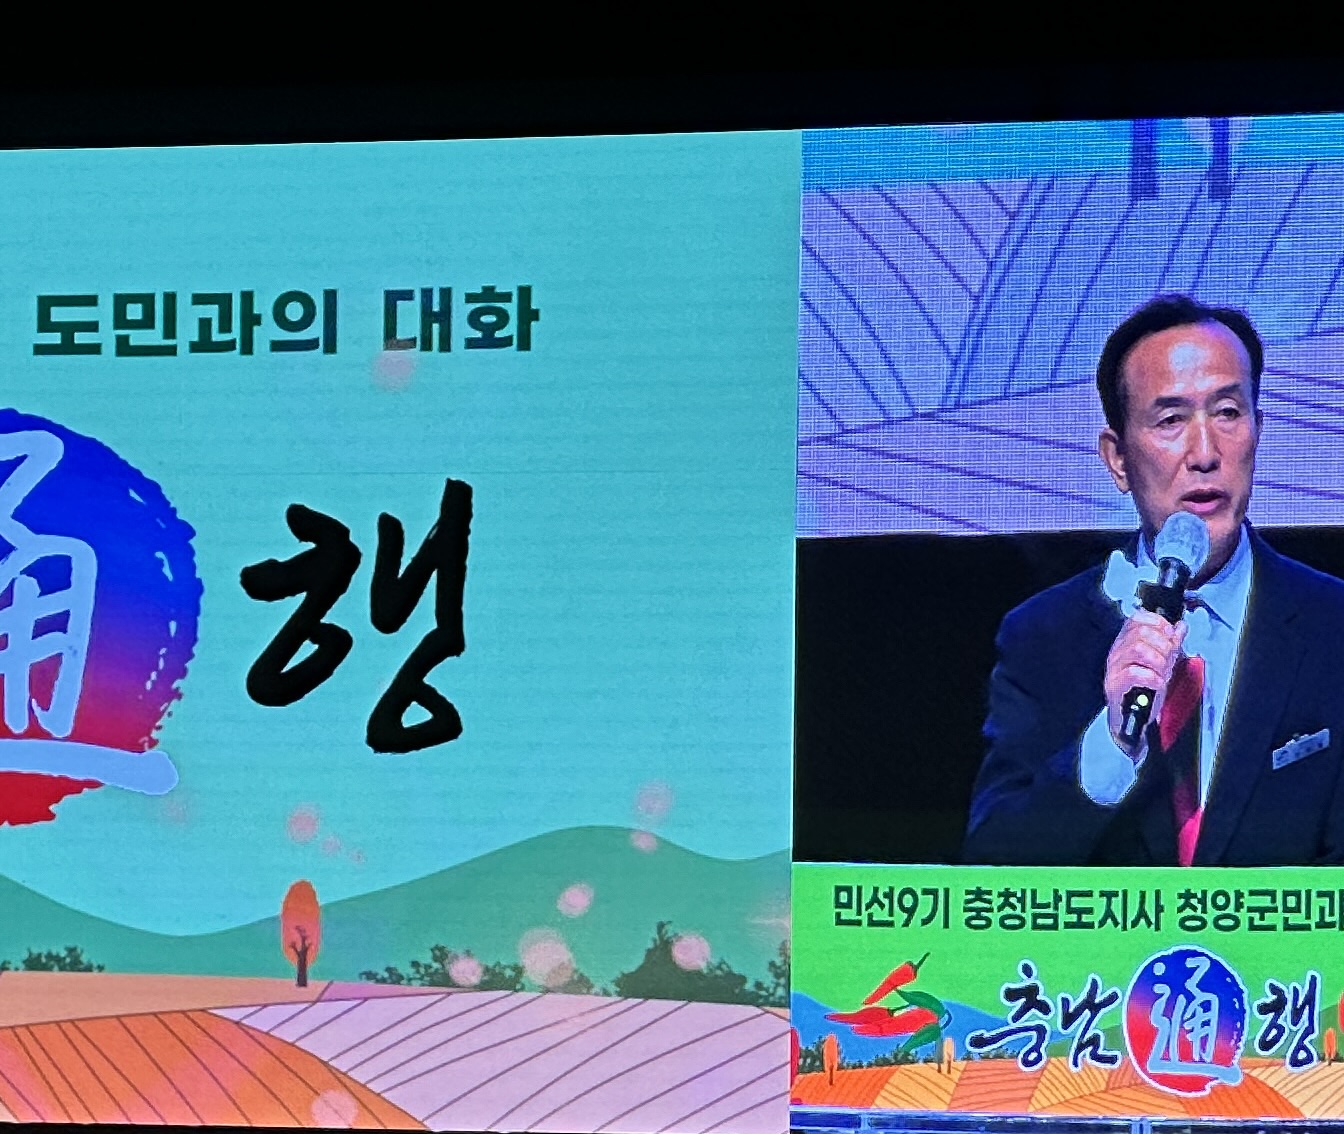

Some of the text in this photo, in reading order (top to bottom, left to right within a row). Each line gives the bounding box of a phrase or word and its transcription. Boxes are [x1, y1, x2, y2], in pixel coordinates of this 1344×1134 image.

[32, 290, 338, 360] 도민과의
[383, 284, 539, 353] 대화
[240, 479, 471, 754] 행
[834, 885, 950, 929] 민선9기
[963, 886, 1164, 931] 충청남도지사
[970, 963, 1118, 1068] 충남
[1256, 972, 1318, 1068] 행
